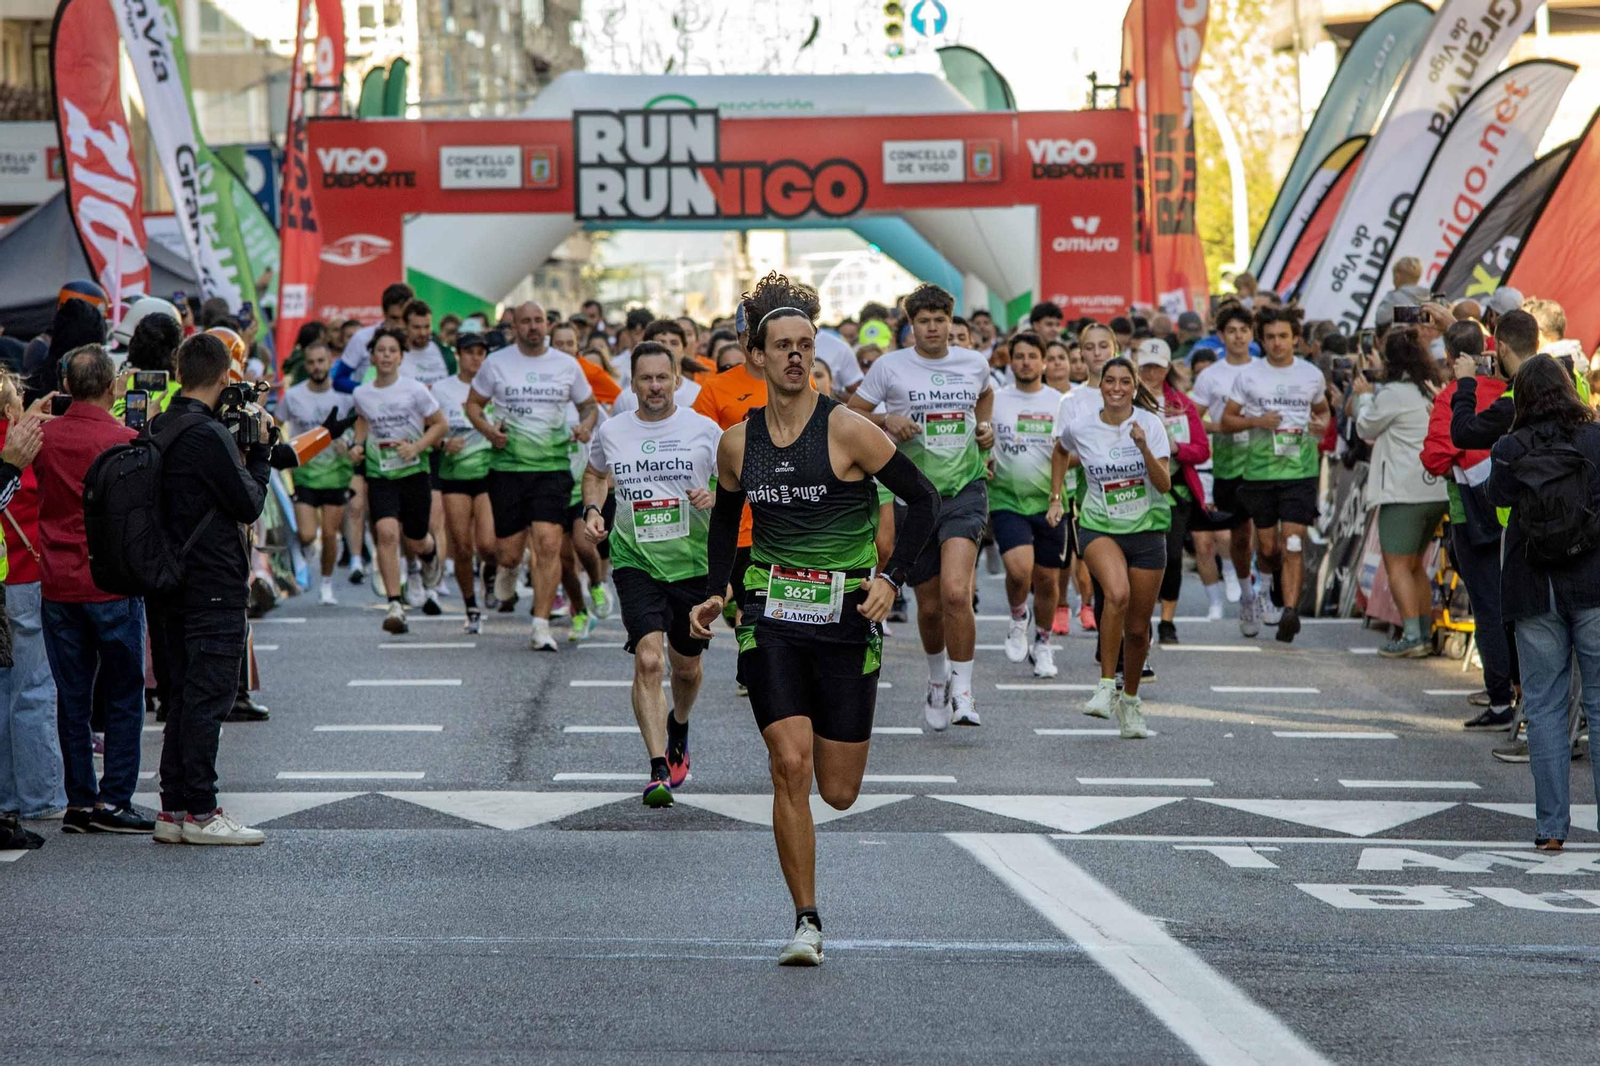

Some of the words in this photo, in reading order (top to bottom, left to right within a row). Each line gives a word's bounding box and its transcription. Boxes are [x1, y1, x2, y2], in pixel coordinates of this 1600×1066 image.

[576, 111, 718, 165] RUN
[889, 149, 957, 161] CONCELLO
[1026, 138, 1098, 165] VIGO
[316, 147, 388, 174] VIGO
[446, 155, 515, 167] CONCELLO
[897, 162, 913, 173] DE
[917, 162, 950, 172] VIGO
[454, 168, 470, 179] DE
[475, 168, 507, 178] VIGO
[1031, 162, 1125, 179] DEPORTE
[322, 170, 416, 188] DEPORTE
[1352, 222, 1371, 250] de
[1052, 236, 1119, 252] amura
[1330, 249, 1363, 293] Vigo
[505, 386, 520, 397] En
[522, 385, 564, 396] Marcha
[908, 389, 926, 401] En
[929, 389, 977, 401] Marcha
[935, 423, 959, 434] 1097
[997, 423, 1012, 433] En
[1000, 442, 1028, 456] Vigo
[613, 461, 632, 475] En
[635, 457, 694, 473] Marcha
[1088, 464, 1104, 475] En
[616, 476, 642, 486] contra
[642, 474, 653, 483] el
[746, 484, 780, 503] máis
[791, 484, 828, 502] auga
[1114, 488, 1138, 503] 1096
[642, 512, 672, 525] 2550
[784, 584, 817, 601] 3621
